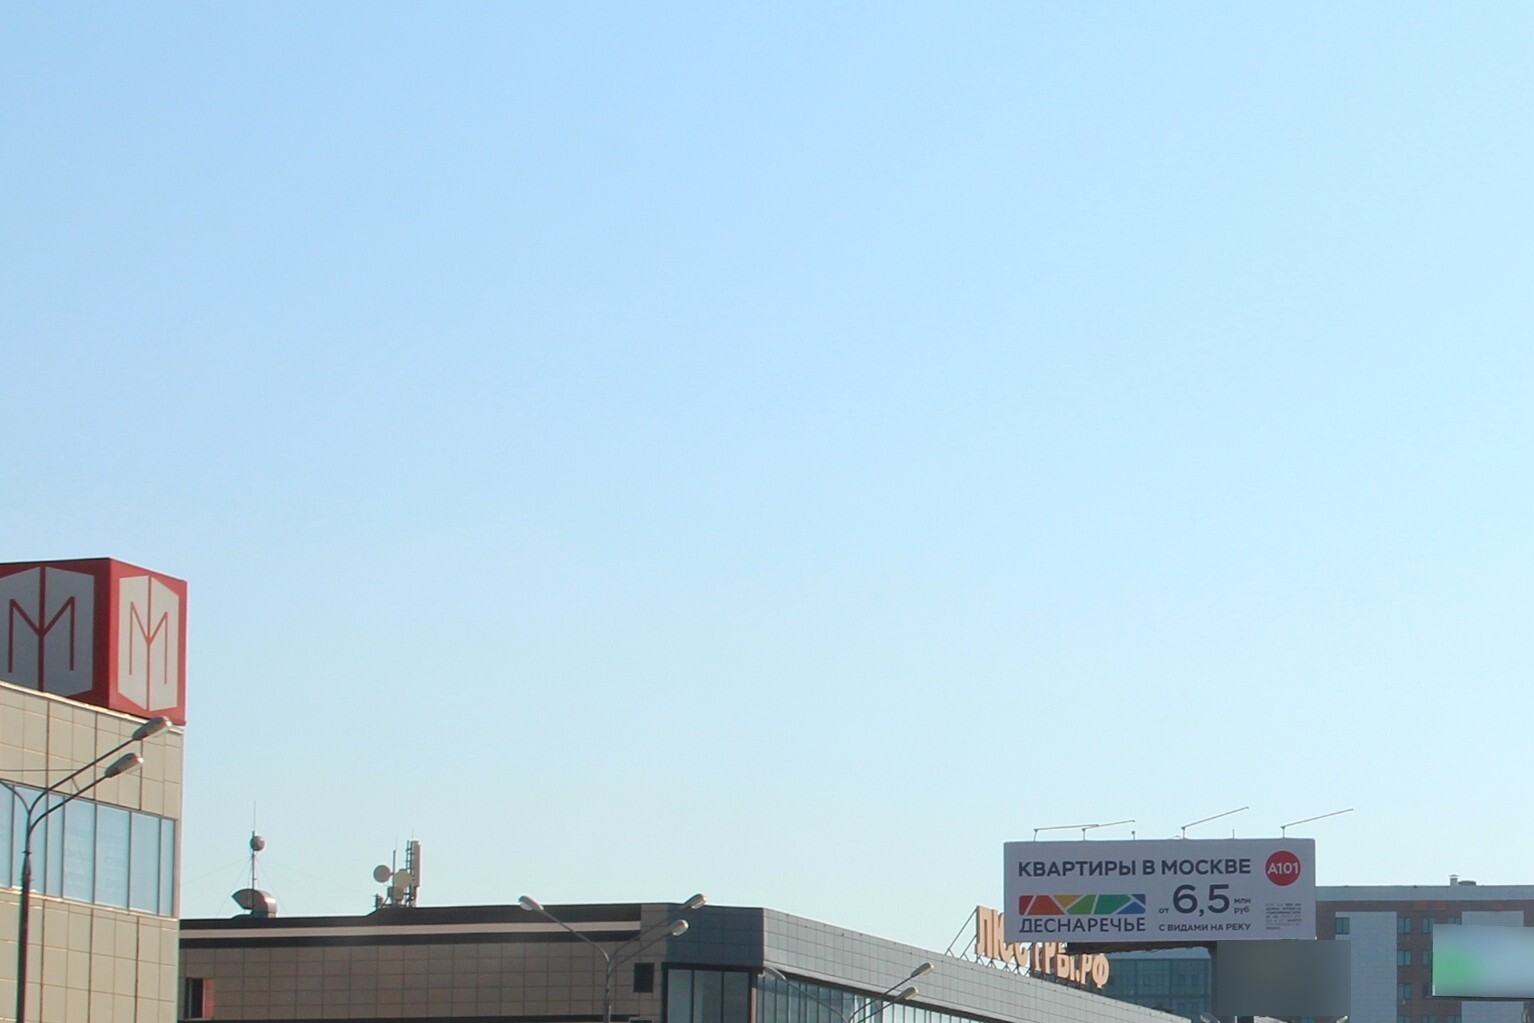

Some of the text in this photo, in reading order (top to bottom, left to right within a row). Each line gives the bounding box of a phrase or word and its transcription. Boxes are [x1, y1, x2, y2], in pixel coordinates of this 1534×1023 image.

[1018, 858, 1251, 877] КВАРТИРЫ В МОСКВЕ
[1267, 861, 1299, 875] А101
[1159, 884, 1230, 917] от 6,5
[1018, 917, 1146, 934] ДЕСНАРЕЧЬЕ
[1159, 923, 1251, 932] С ВИДАМИ НА РЕКУ
